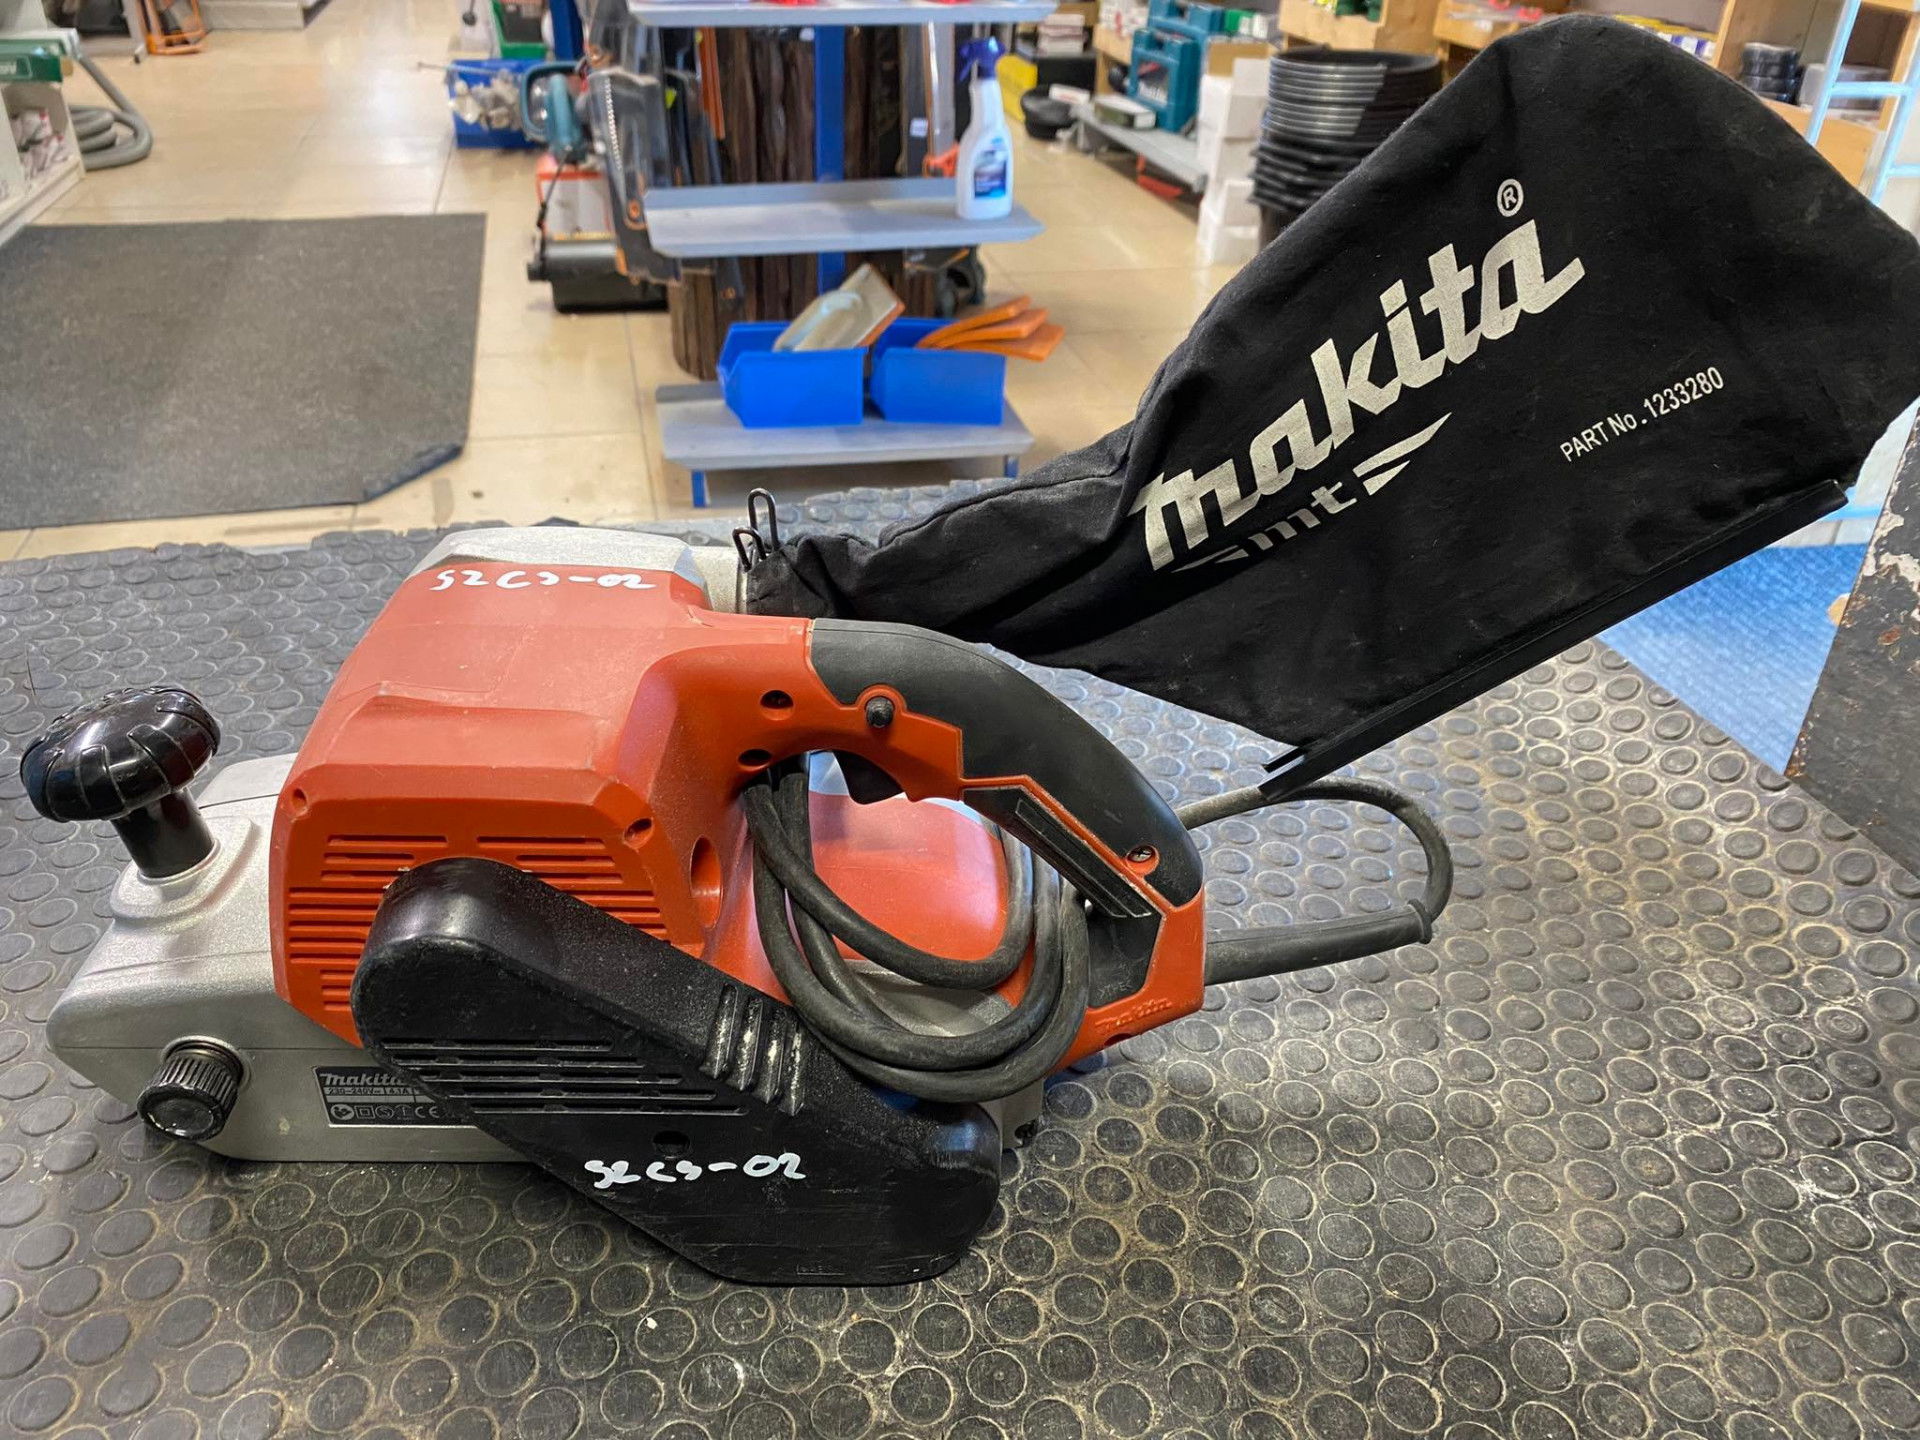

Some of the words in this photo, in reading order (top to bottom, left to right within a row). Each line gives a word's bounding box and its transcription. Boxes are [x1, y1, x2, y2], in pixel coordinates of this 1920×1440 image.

[1127, 218, 1585, 571] makita
[1560, 422, 1608, 462] PART
[1607, 413, 1648, 436] No.
[1643, 366, 1724, 418] 1233280
